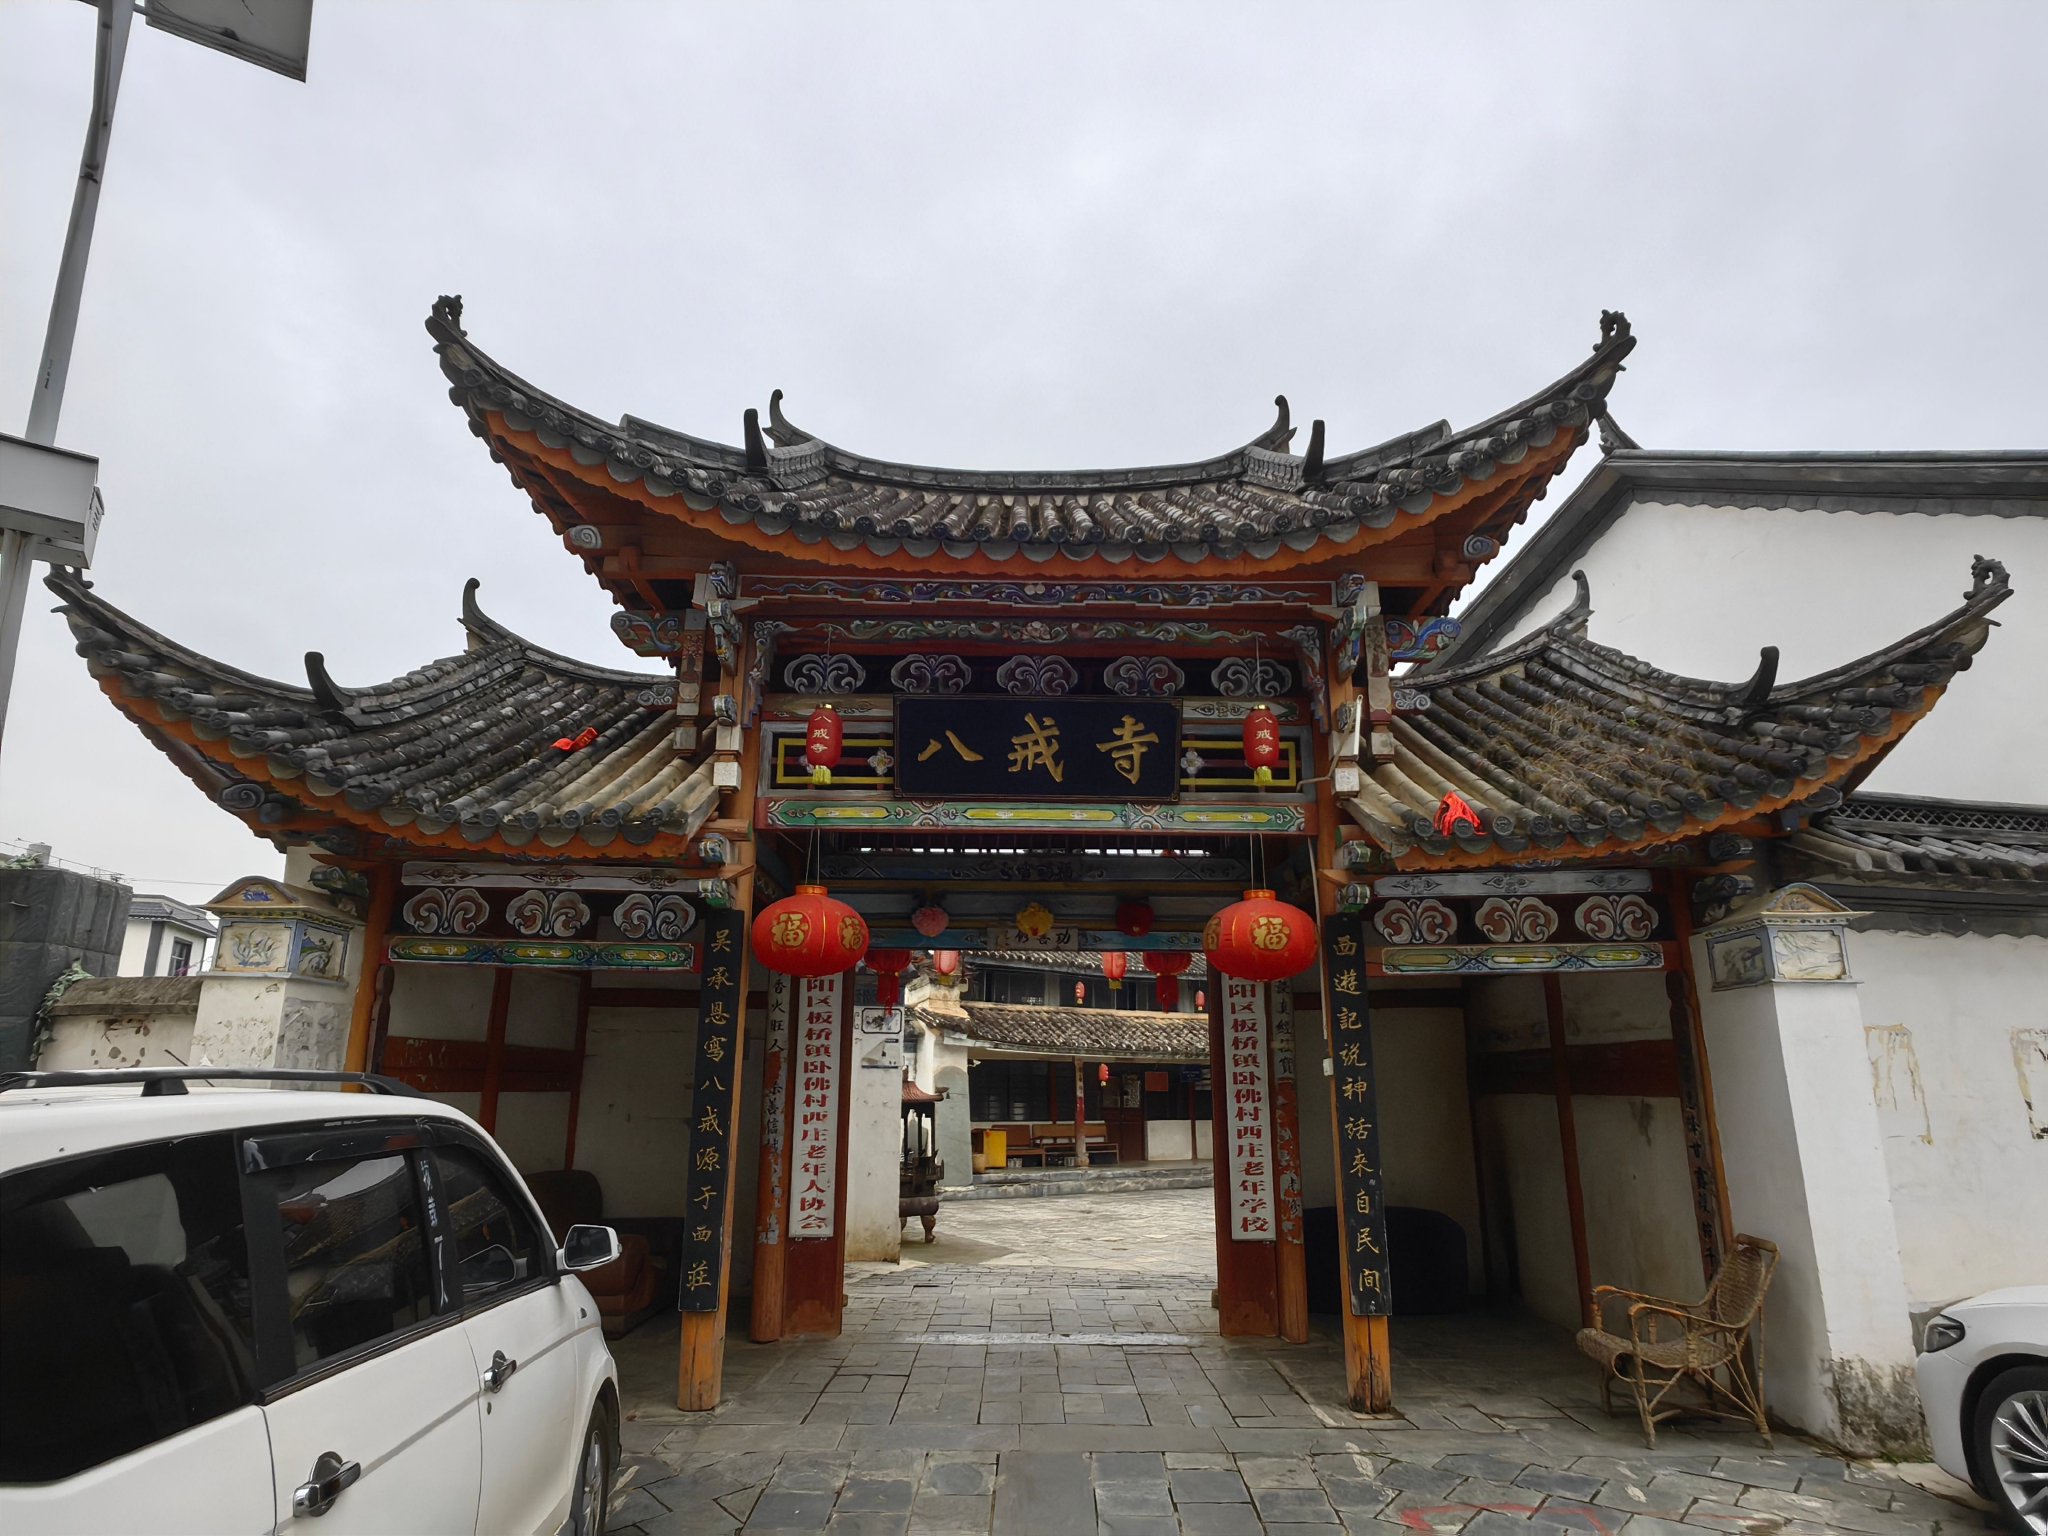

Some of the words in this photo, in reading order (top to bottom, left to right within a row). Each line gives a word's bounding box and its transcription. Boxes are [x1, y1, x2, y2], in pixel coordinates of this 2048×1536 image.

[811, 715, 833, 754] 八戒寺
[917, 712, 1159, 785] 八戒寺
[1254, 716, 1274, 755] 八戒寺
[770, 912, 810, 948] 福
[1252, 916, 1291, 950] 福
[1228, 974, 1271, 1233] 阳区板桥镇卧佛村西庄老年学校
